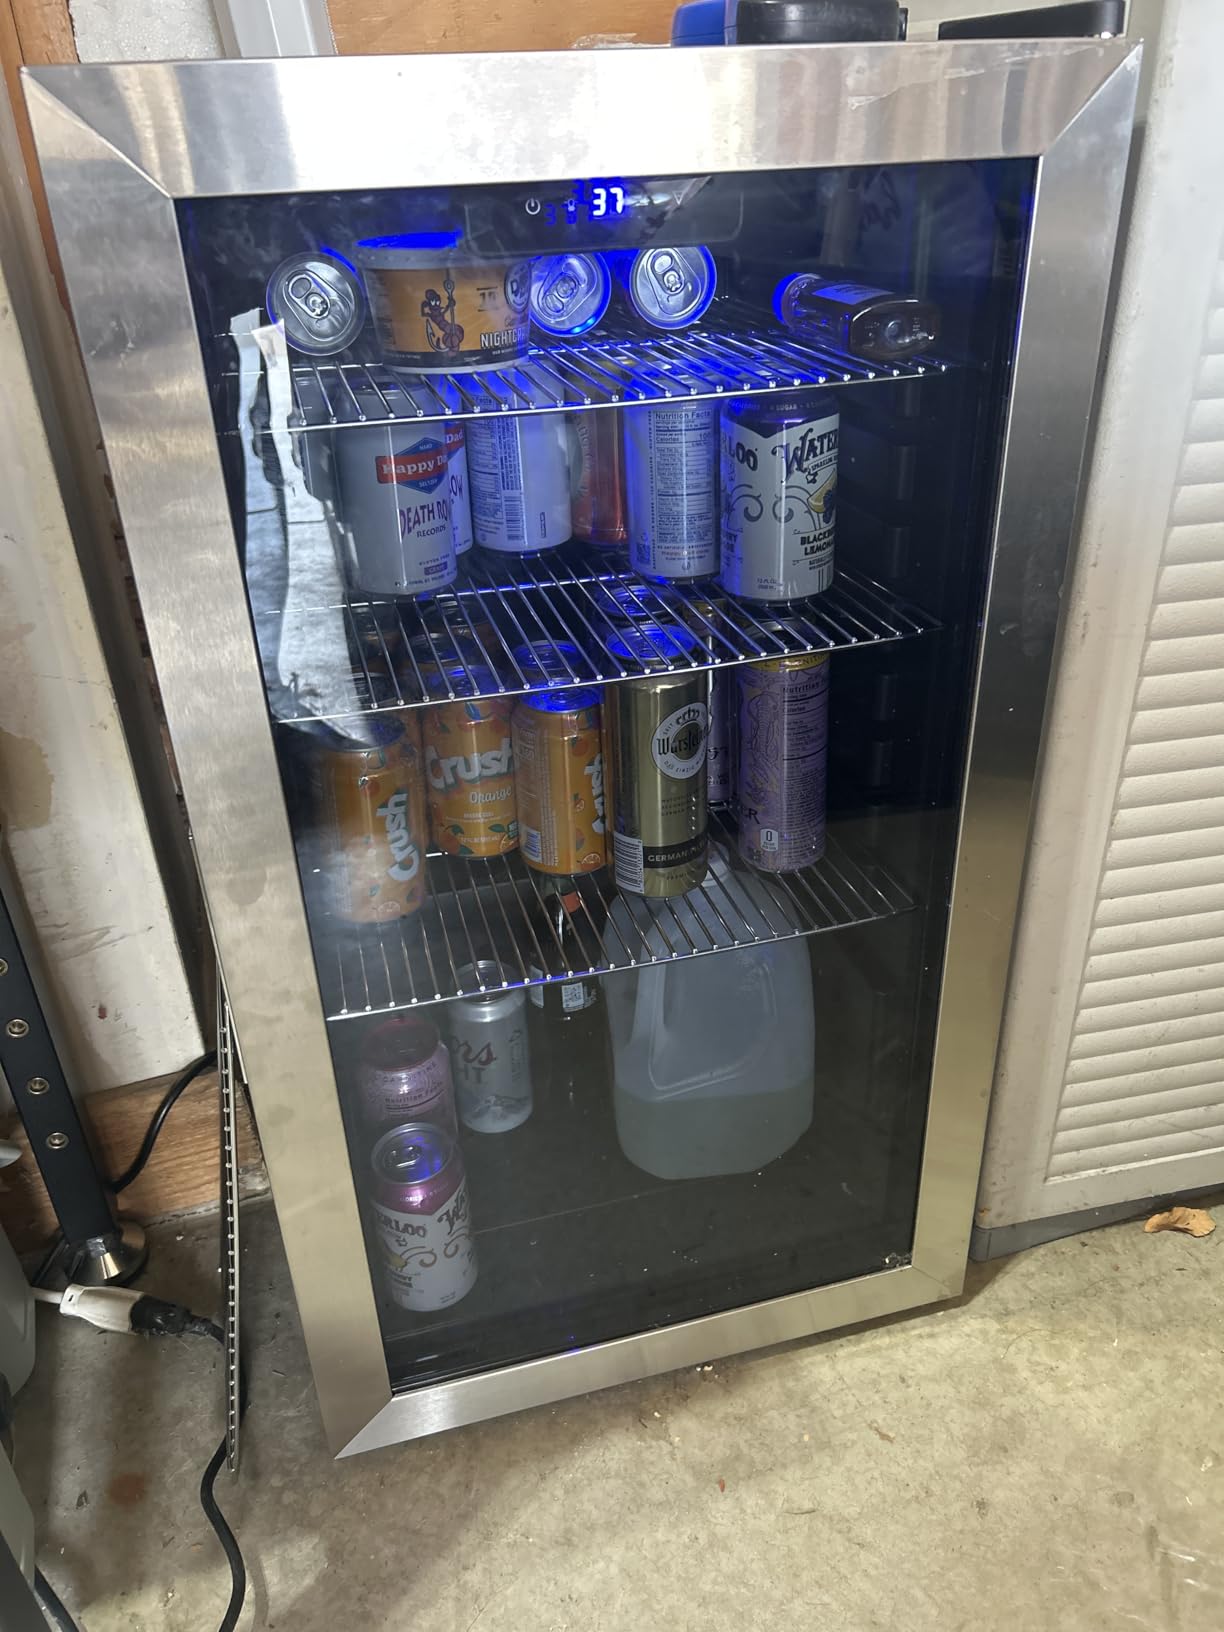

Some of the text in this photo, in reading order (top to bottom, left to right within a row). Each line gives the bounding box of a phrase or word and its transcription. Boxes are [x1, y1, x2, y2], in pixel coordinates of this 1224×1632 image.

[593, 187, 624, 216] 37
[655, 411, 690, 420] Nutrition
[446, 430, 464, 444] Dad
[721, 432, 758, 472] LOO
[382, 459, 434, 475] Happy
[450, 474, 464, 500] OW
[399, 499, 449, 540] DEATH RO
[416, 524, 446, 538] RECORDS
[469, 786, 512, 804] Orange
[376, 792, 420, 881] Crush
[647, 849, 687, 862] GERMAN
